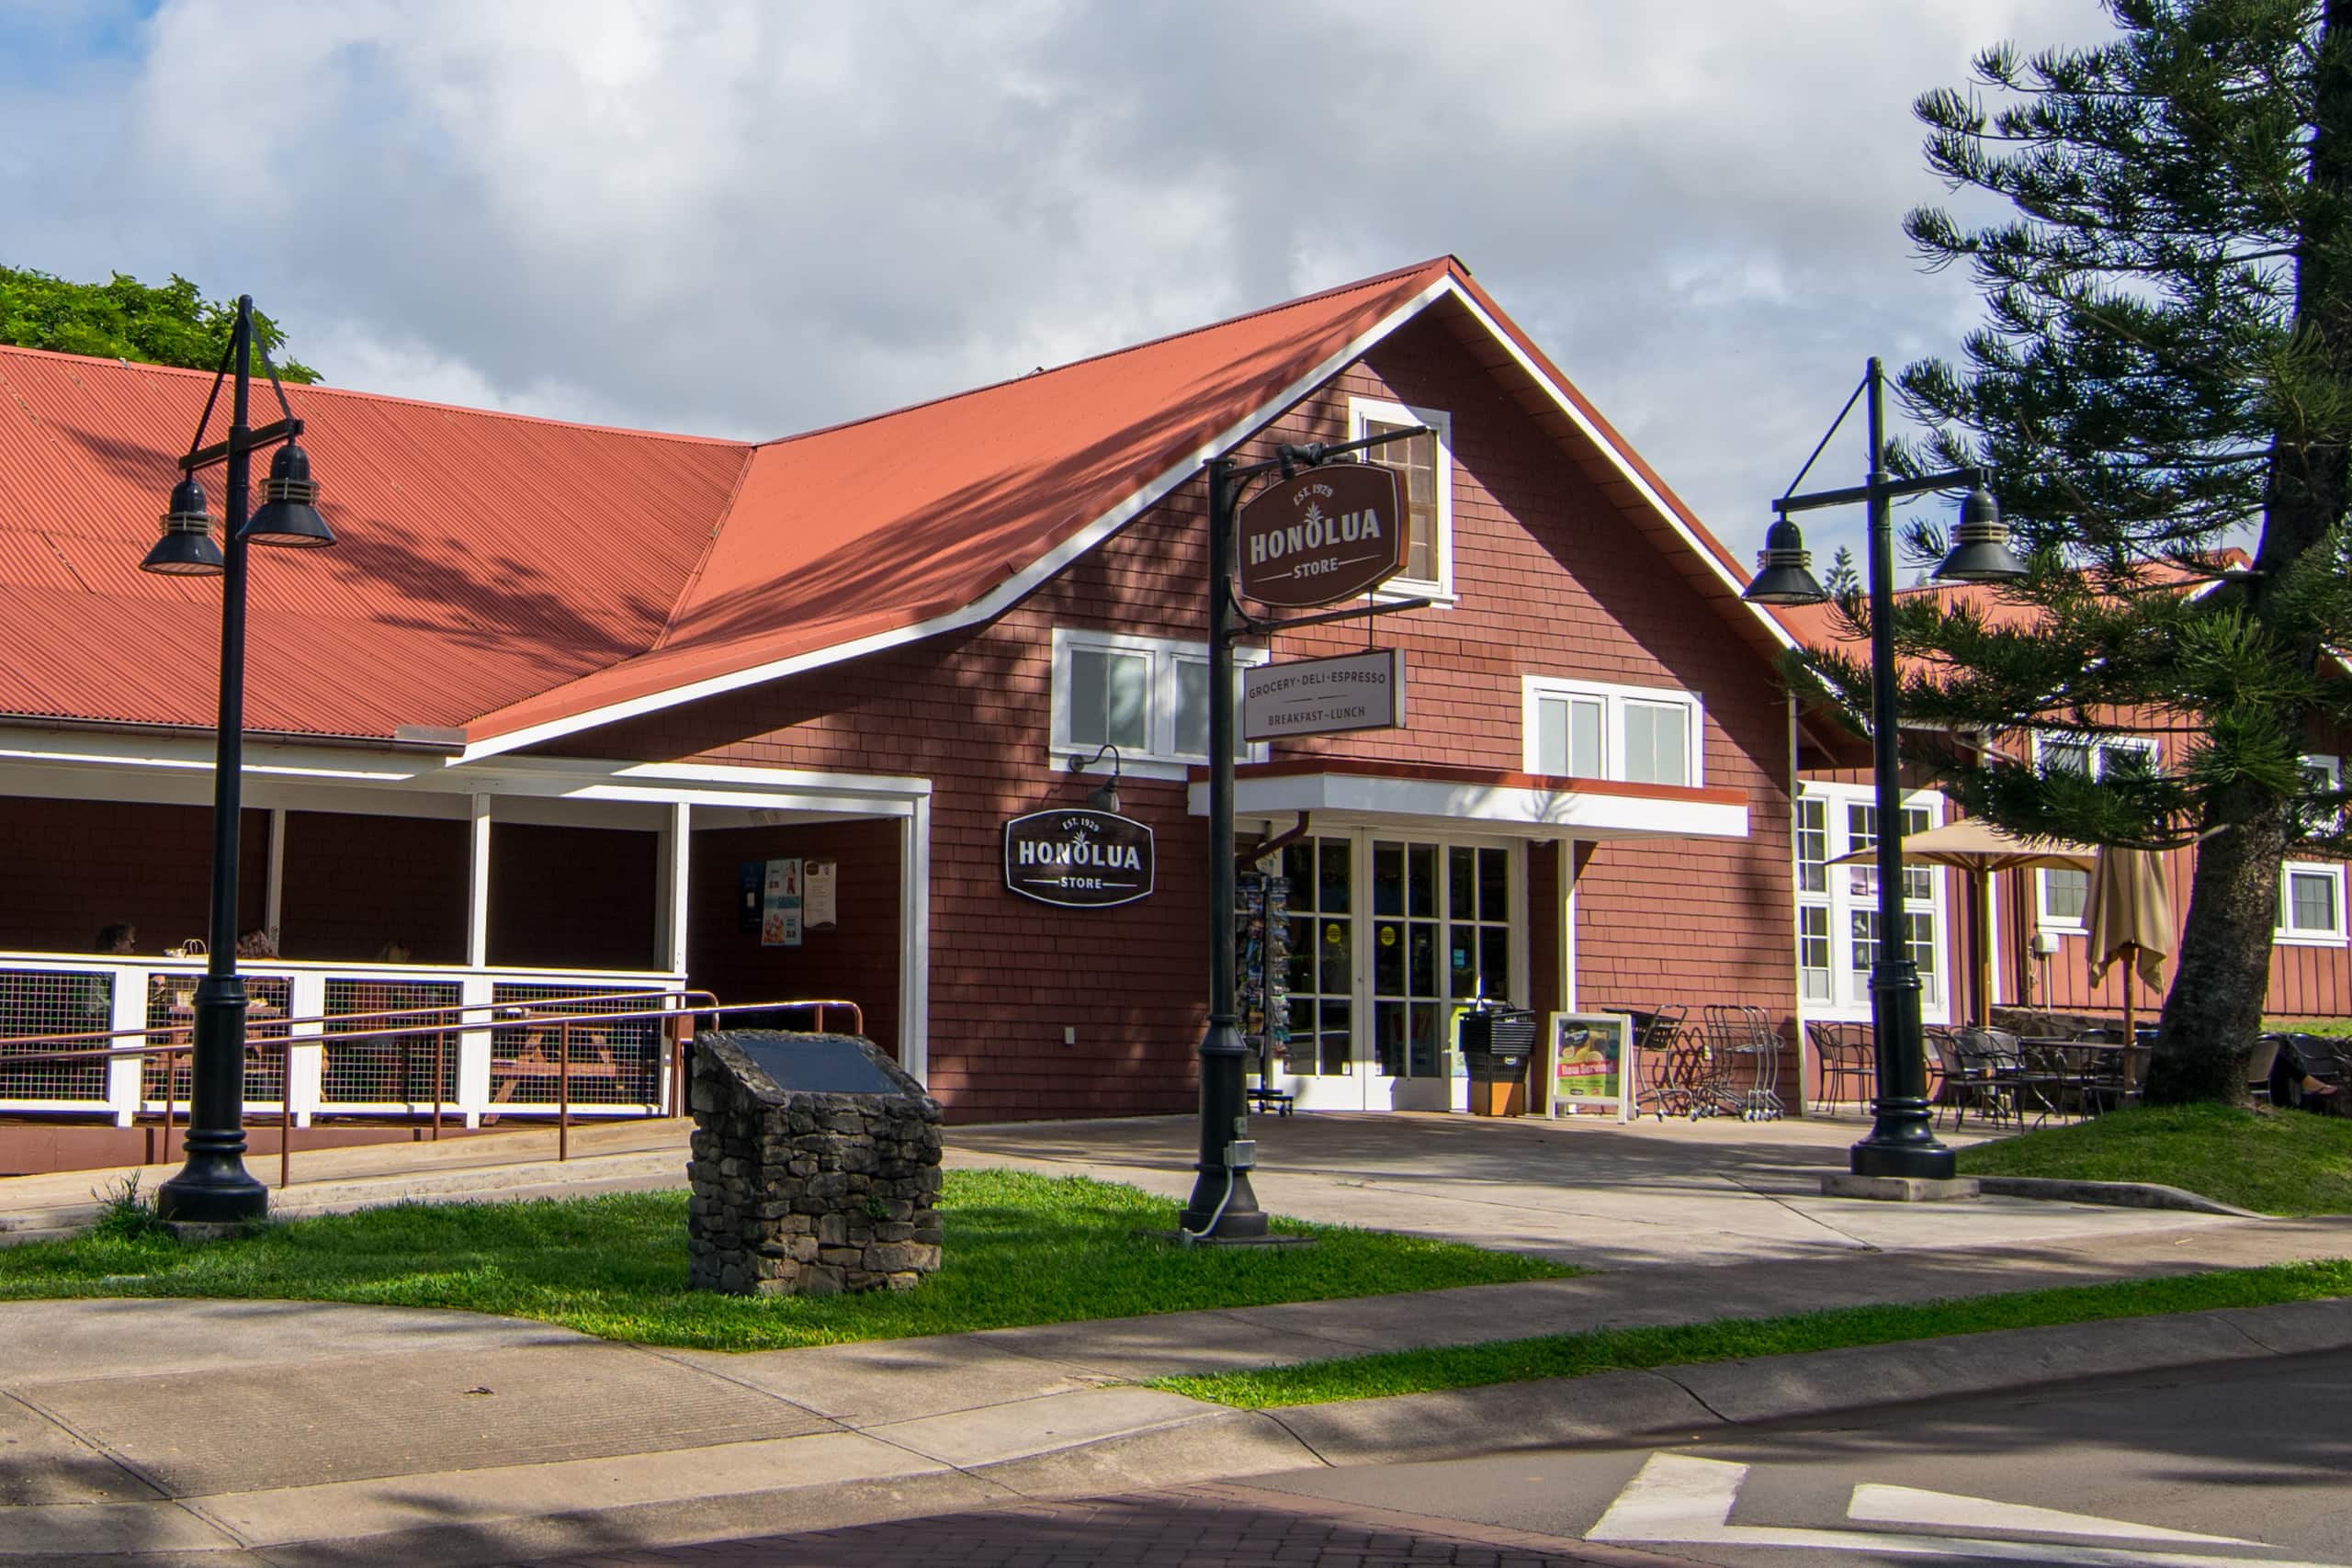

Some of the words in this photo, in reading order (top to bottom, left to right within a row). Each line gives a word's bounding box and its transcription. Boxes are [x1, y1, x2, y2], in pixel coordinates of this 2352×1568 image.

[1312, 483, 1334, 499] 1929
[1250, 508, 1381, 565] HONOLUA
[1294, 558, 1339, 579] STORE
[1249, 677, 1296, 699] GROCERY
[1302, 673, 1326, 686] DELI
[1331, 671, 1385, 684] ESPRESSO
[1268, 710, 1324, 726] BREAKFAST
[1330, 705, 1366, 720] LUNCH
[1080, 817, 1101, 832] 1929
[1019, 840, 1141, 870] HONOLUA
[1060, 876, 1102, 889] STORE
